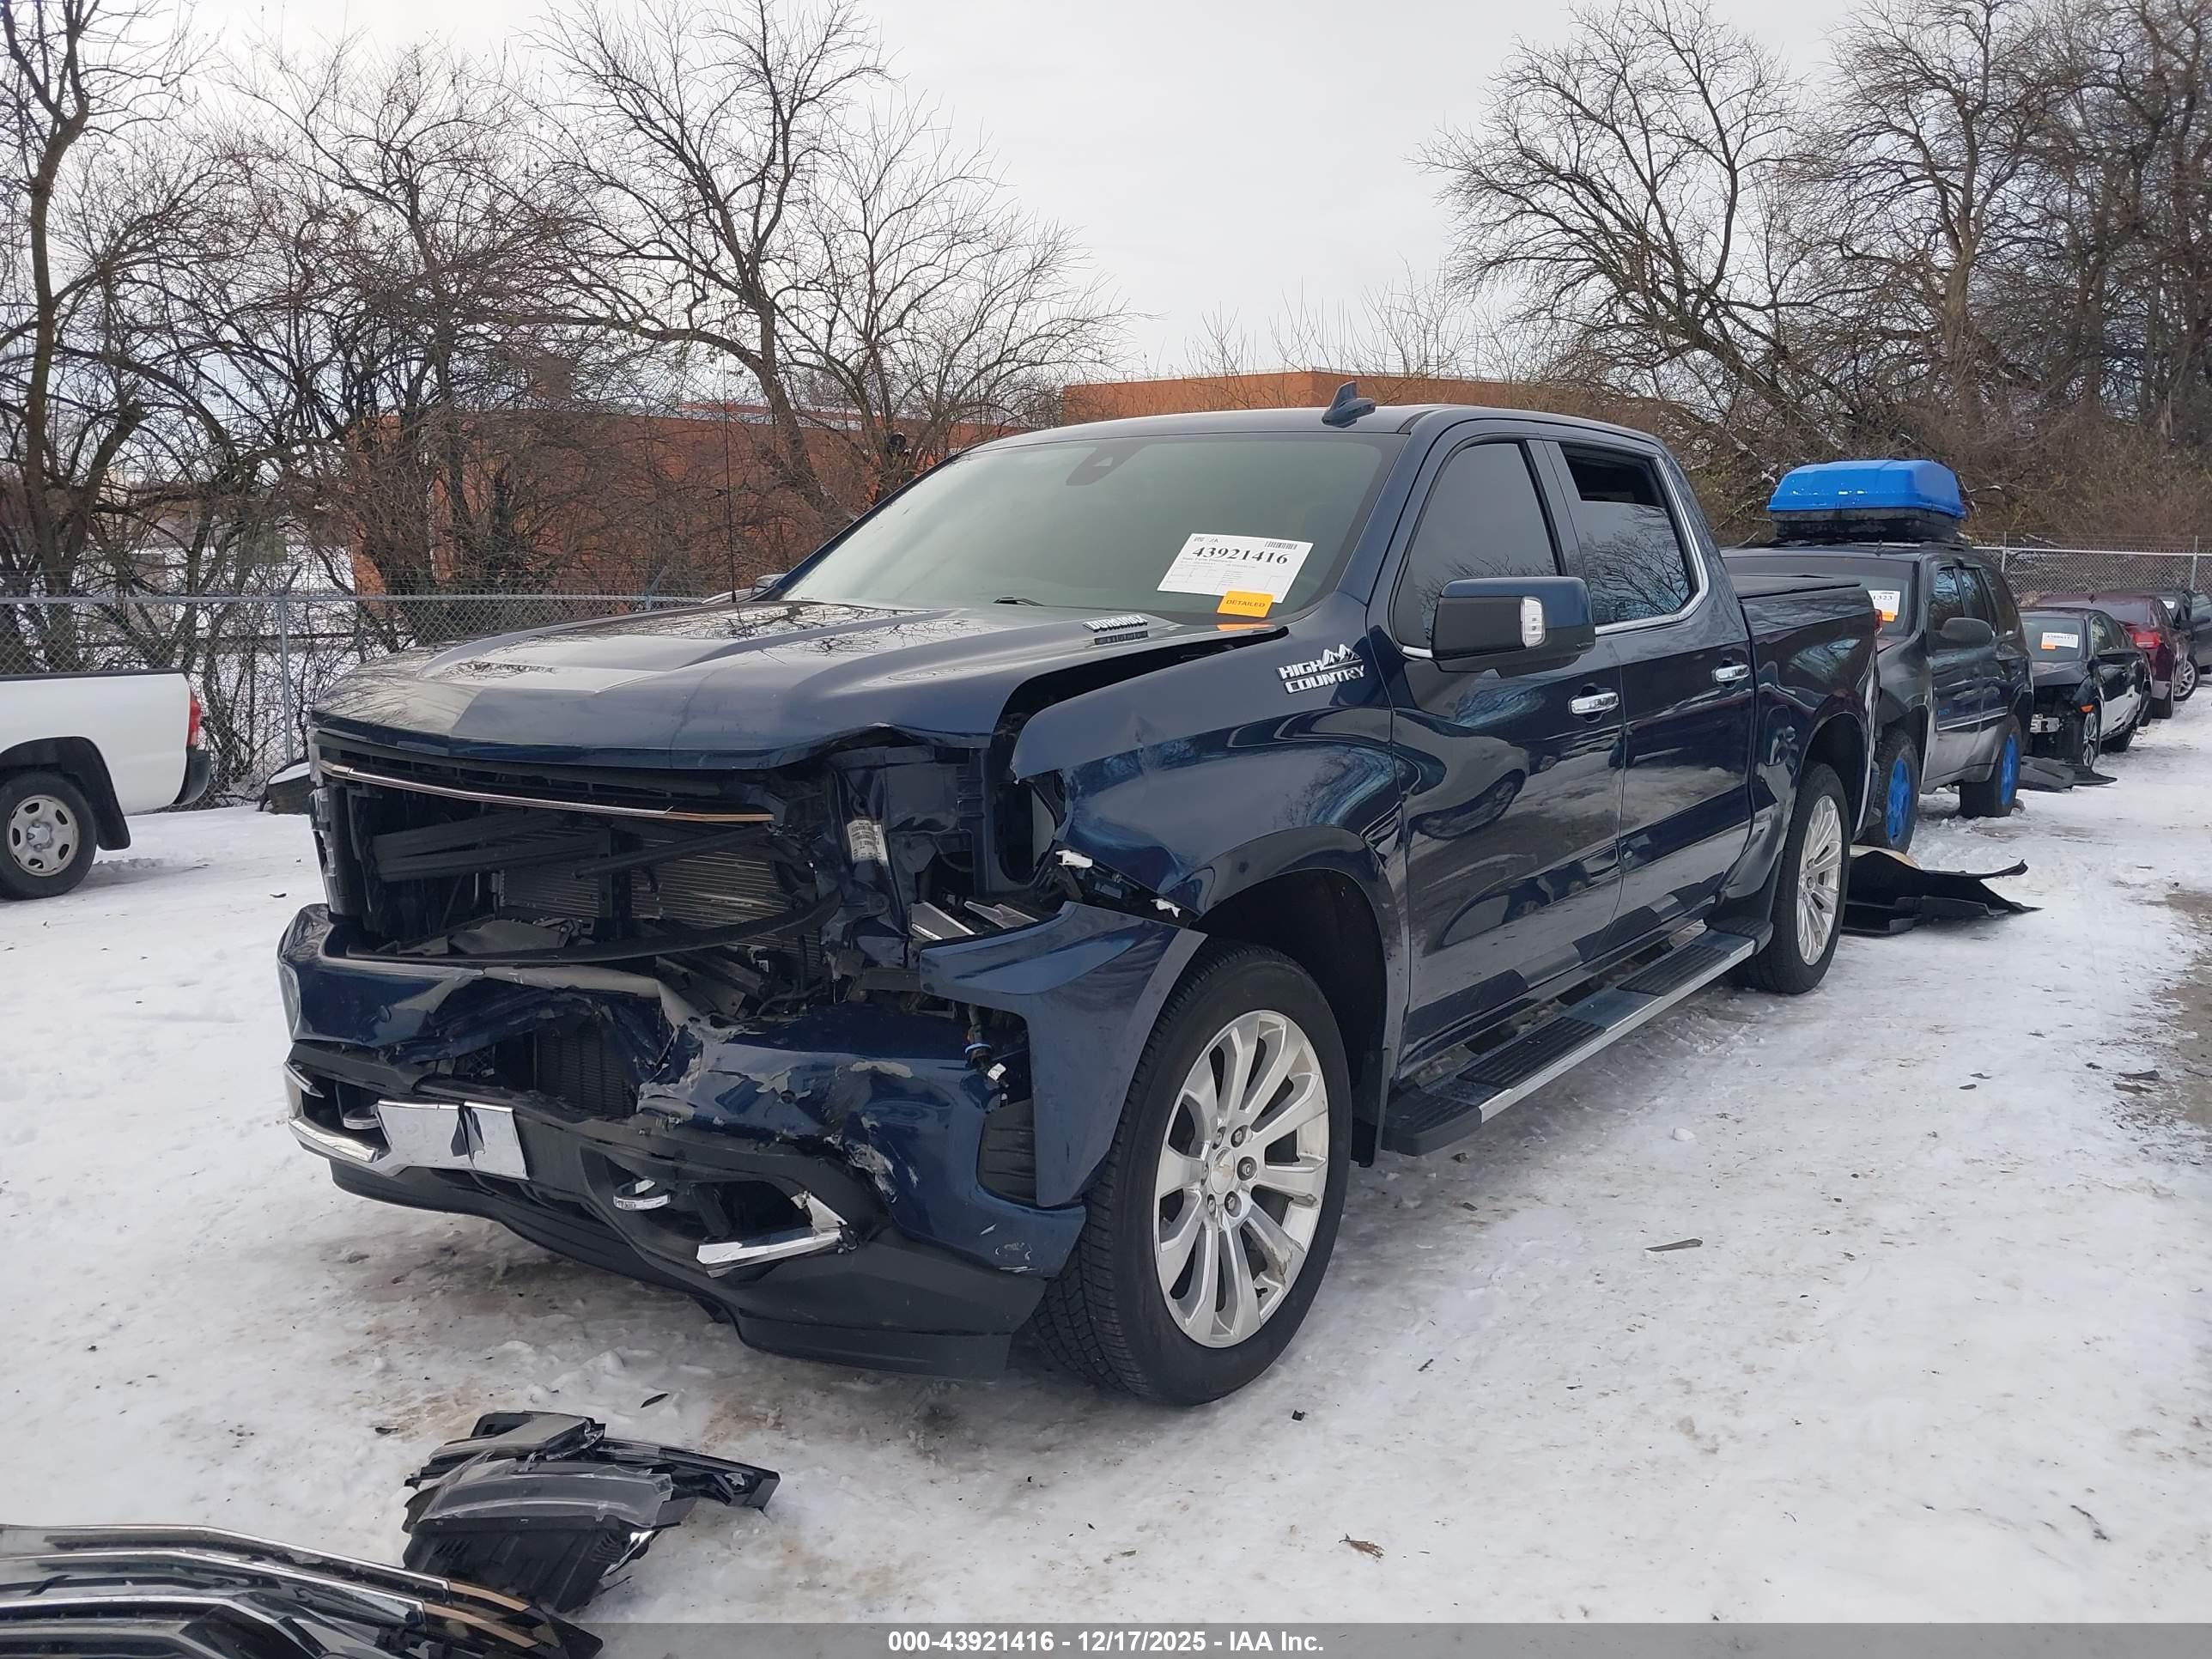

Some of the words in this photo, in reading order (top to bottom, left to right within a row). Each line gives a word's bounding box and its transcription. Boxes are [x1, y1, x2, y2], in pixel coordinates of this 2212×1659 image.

[1192, 546, 1290, 565] 43921416
[1225, 599, 1266, 608] DETAILED
[1084, 615, 1148, 633] DURAMAX
[1278, 659, 1322, 680] HIGH
[1285, 665, 1364, 694] COUNTRY
